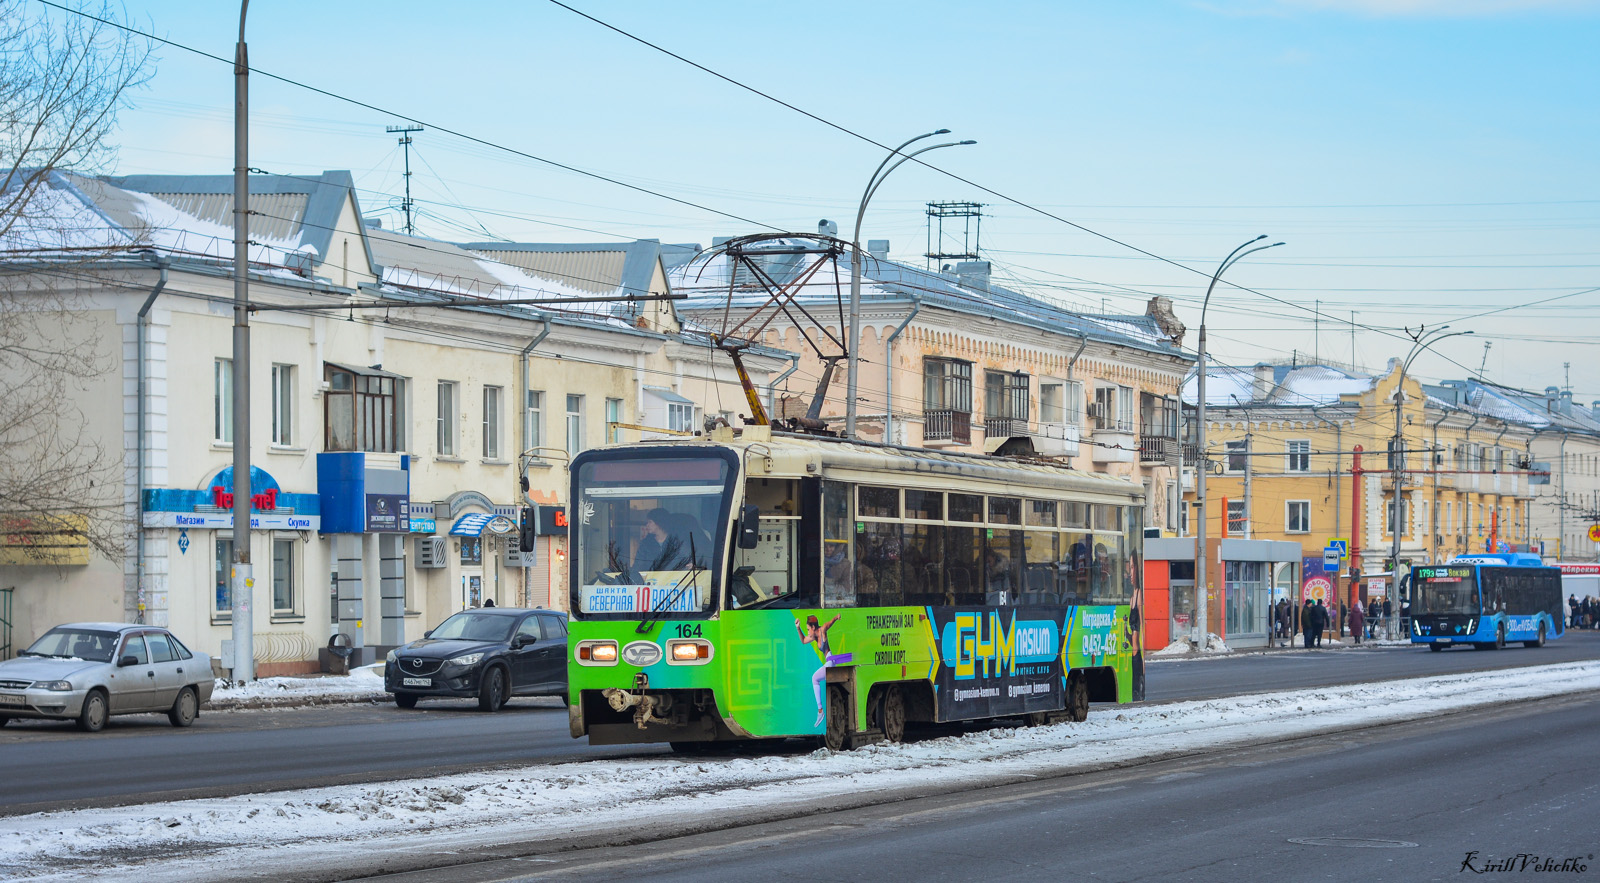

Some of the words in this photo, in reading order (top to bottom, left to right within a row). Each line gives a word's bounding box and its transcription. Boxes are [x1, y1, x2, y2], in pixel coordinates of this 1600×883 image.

[176, 515, 205, 525] Магазин
[288, 518, 310, 529] Скупка
[181, 536, 188, 549] 22
[589, 595, 633, 611] СЕВЕРНАЯ
[636, 587, 650, 612] 10
[652, 589, 693, 611] ВОКЗАЛ
[866, 612, 903, 629] ТРЕНАЖЕРНЫЙ
[904, 614, 914, 628] ЗАЛ
[675, 624, 702, 638] 164
[881, 632, 900, 647] ФИТНЕС
[1089, 633, 1117, 656] 452-432
[875, 651, 893, 665] СКВОШ
[893, 650, 906, 664] КОРТ
[1016, 666, 1035, 676] ФИТНЕС
[1037, 665, 1050, 674] КЛУБ
